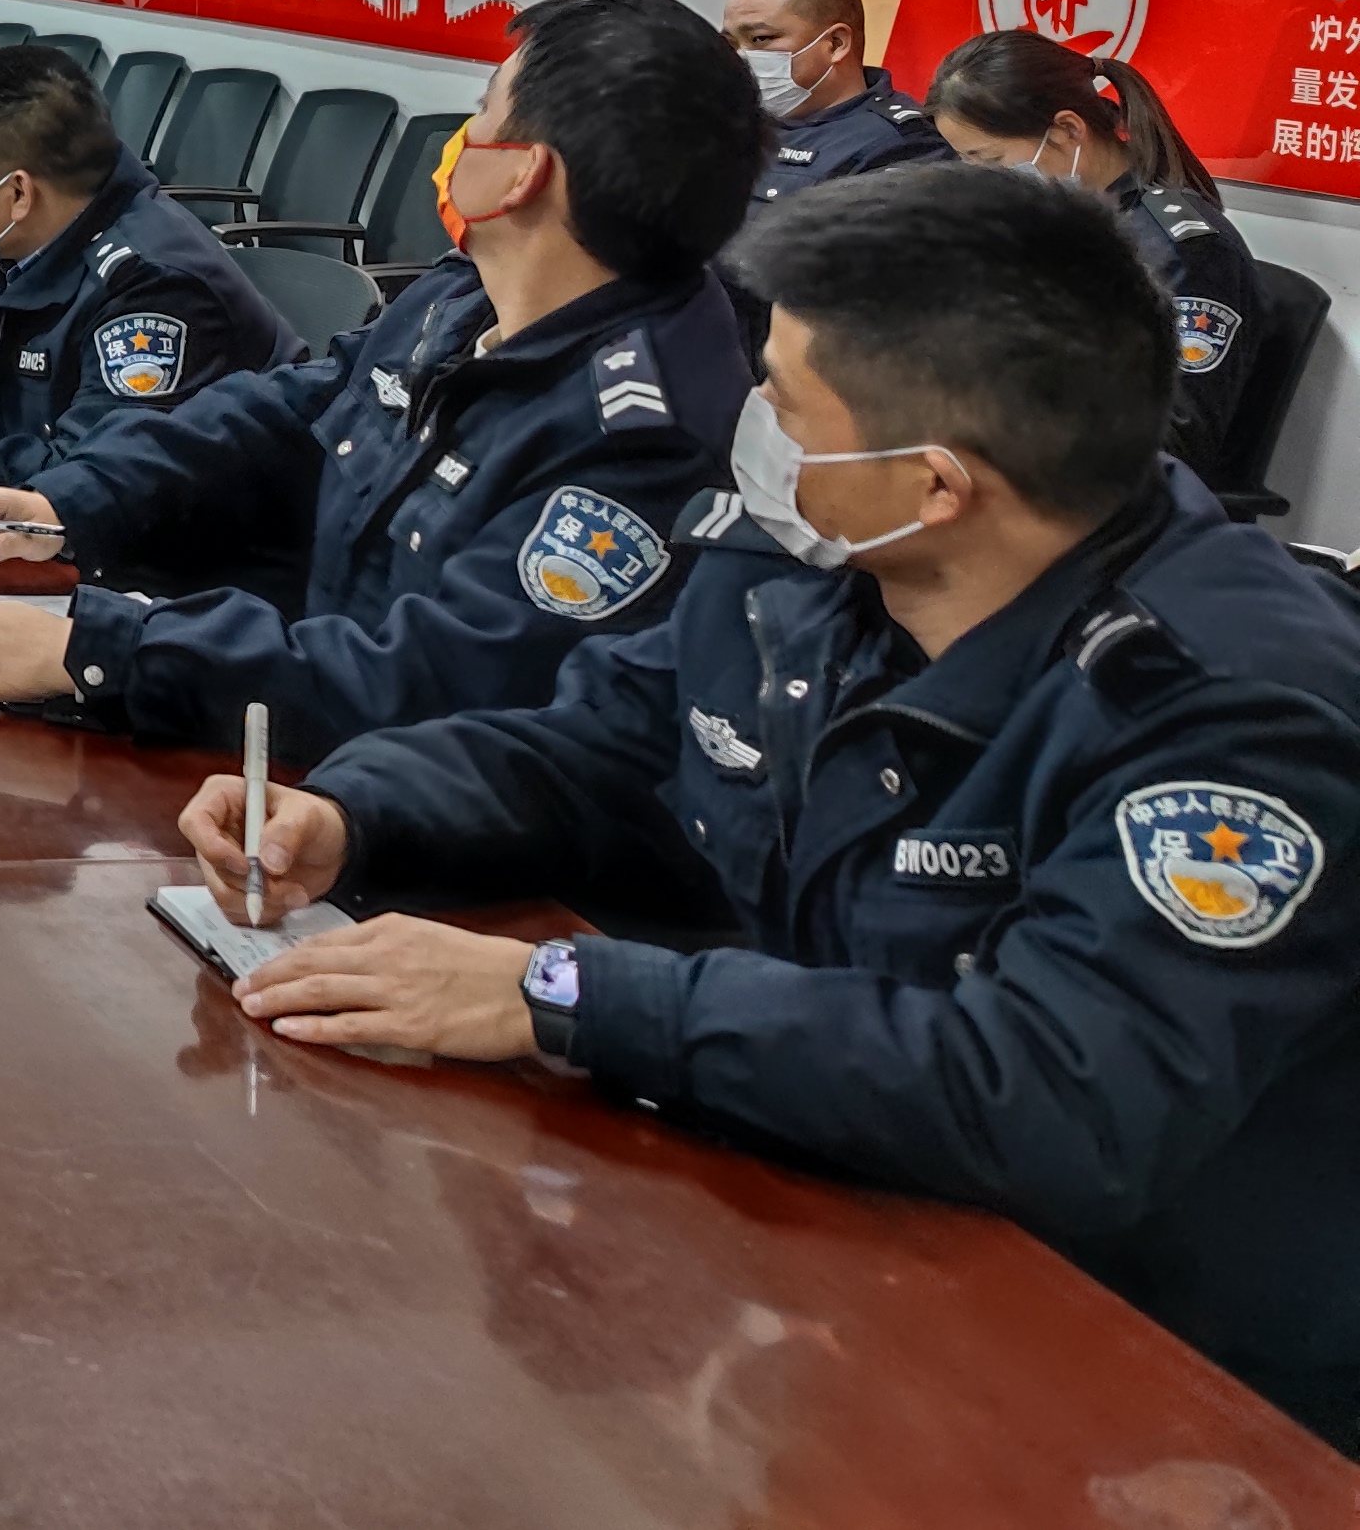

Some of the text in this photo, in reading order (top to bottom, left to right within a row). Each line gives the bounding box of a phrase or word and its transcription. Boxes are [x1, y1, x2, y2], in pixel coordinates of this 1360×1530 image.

[1290, 67, 1360, 110] 量发
[100, 317, 180, 342] 中华人民共和国
[105, 336, 176, 359] 保 卫
[611, 551, 645, 586] 卫
[1147, 826, 1302, 877] 保 卫
